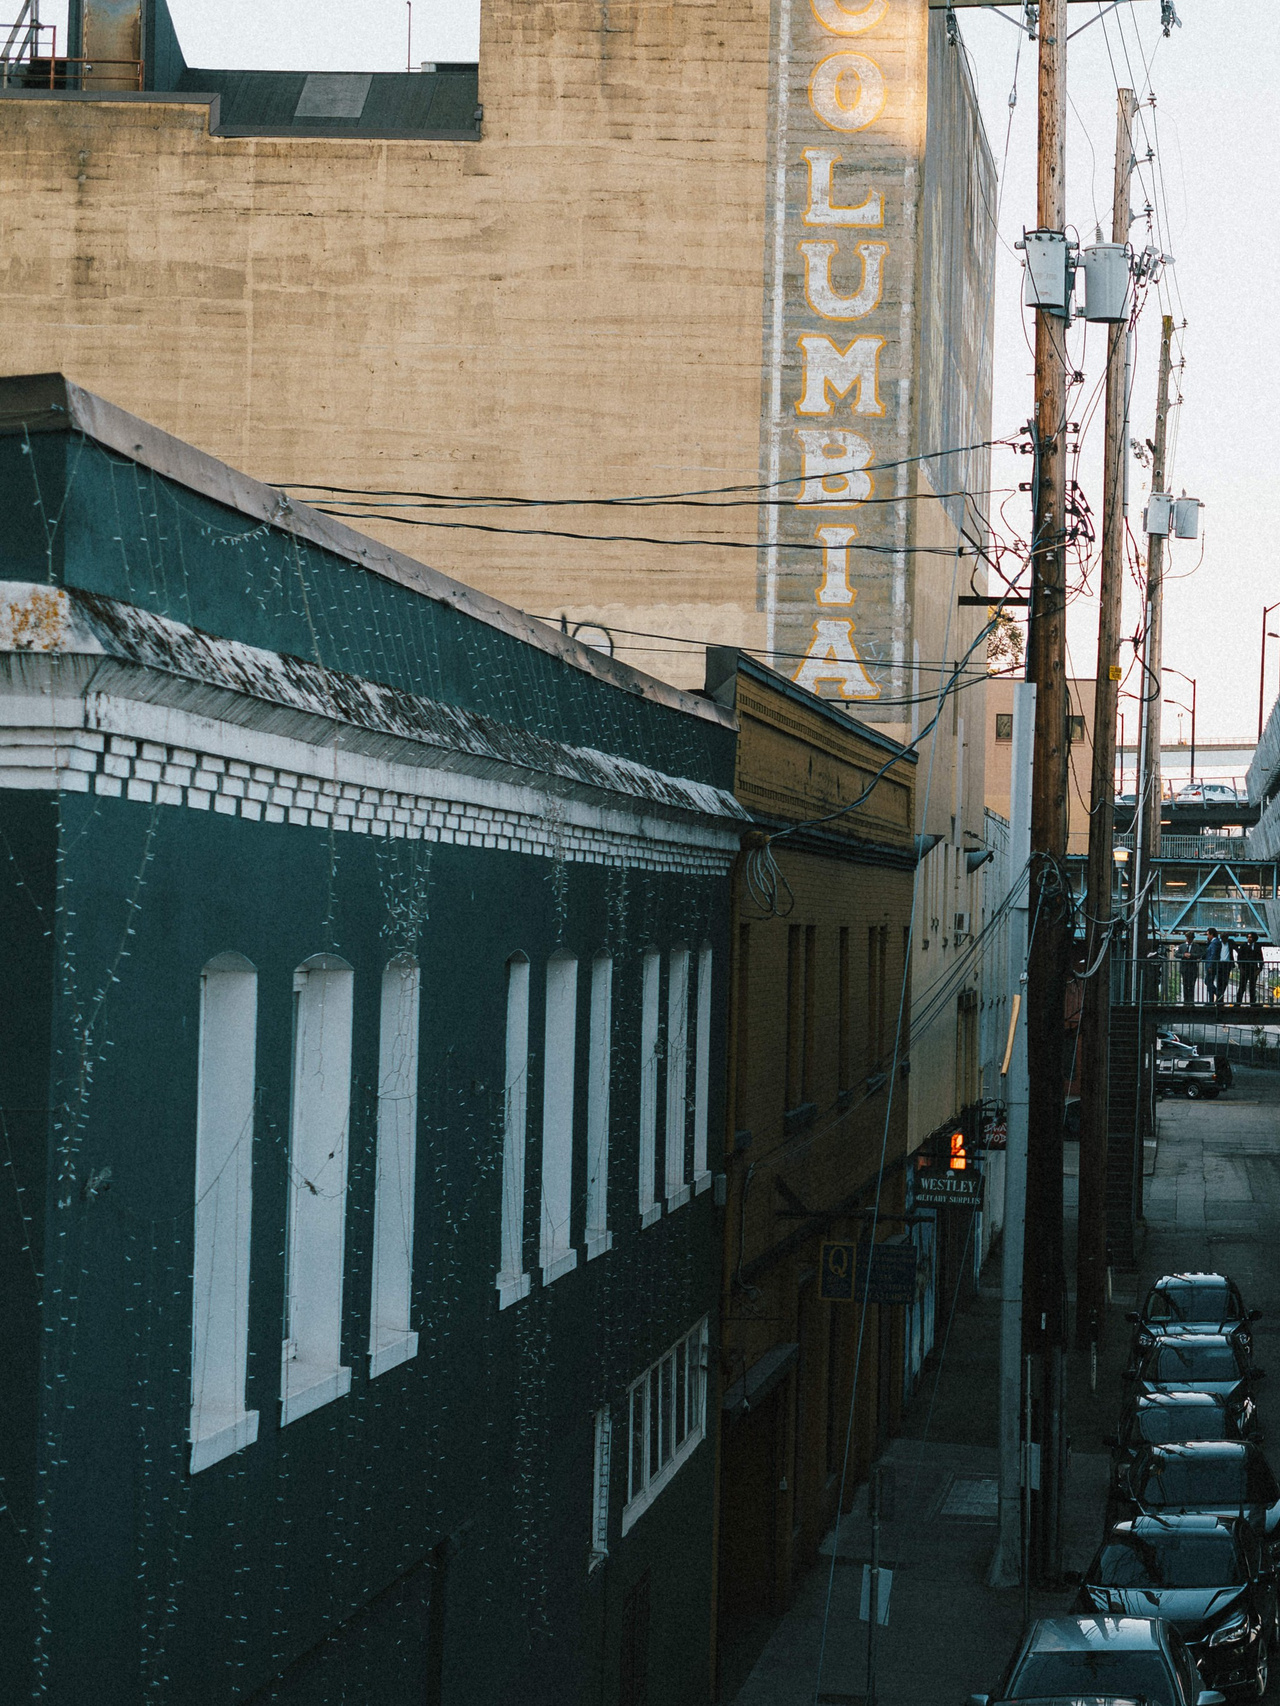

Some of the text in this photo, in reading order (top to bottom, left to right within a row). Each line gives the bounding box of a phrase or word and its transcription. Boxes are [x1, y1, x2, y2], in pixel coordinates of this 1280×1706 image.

[920, 1177, 977, 1193] WESTLEY
[949, 1195, 982, 1205] SURPLUS
[828, 1246, 848, 1278] Q
